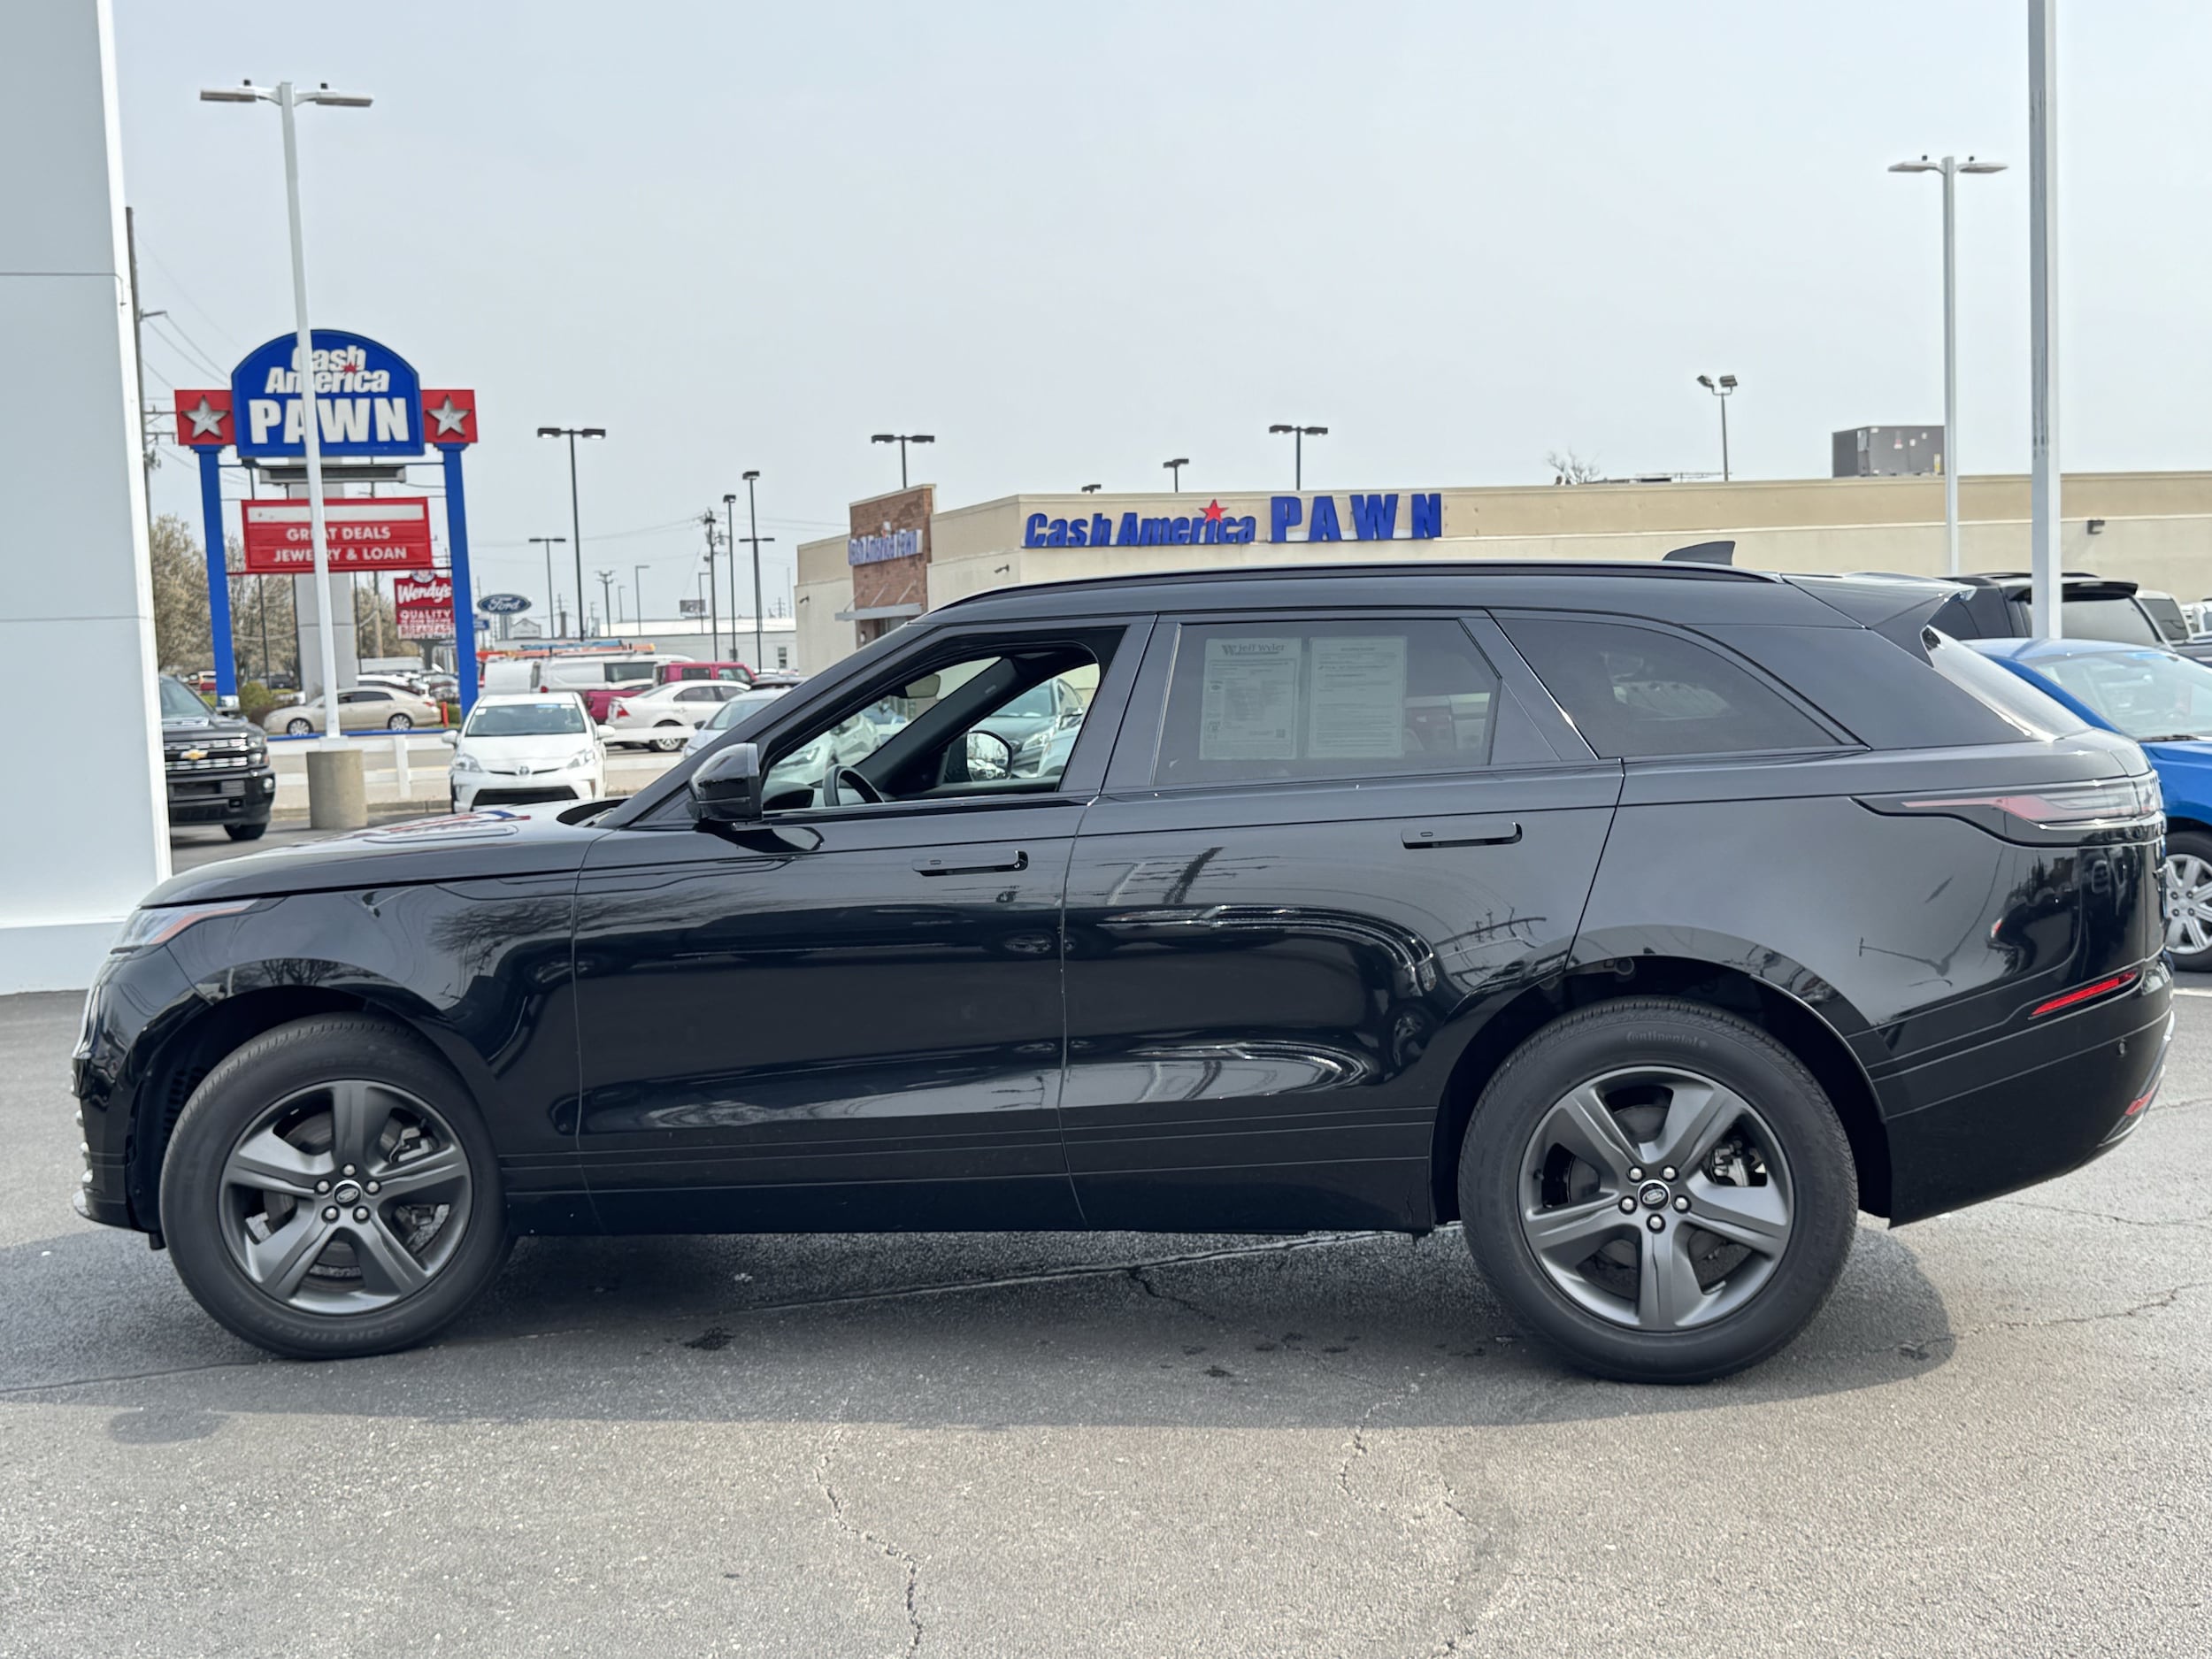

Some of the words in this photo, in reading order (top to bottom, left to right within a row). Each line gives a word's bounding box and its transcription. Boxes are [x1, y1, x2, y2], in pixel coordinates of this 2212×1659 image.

[249, 397, 410, 444] PAWN
[1025, 512, 1112, 547] Cash
[1117, 511, 1256, 545] America
[1270, 493, 1442, 542] PAWN
[286, 527, 337, 541] GRT
[342, 526, 391, 540] DEALS
[273, 548, 341, 562] JEWERY
[346, 547, 357, 561] &
[363, 546, 407, 560] LOAN
[397, 580, 452, 604] Wendy's
